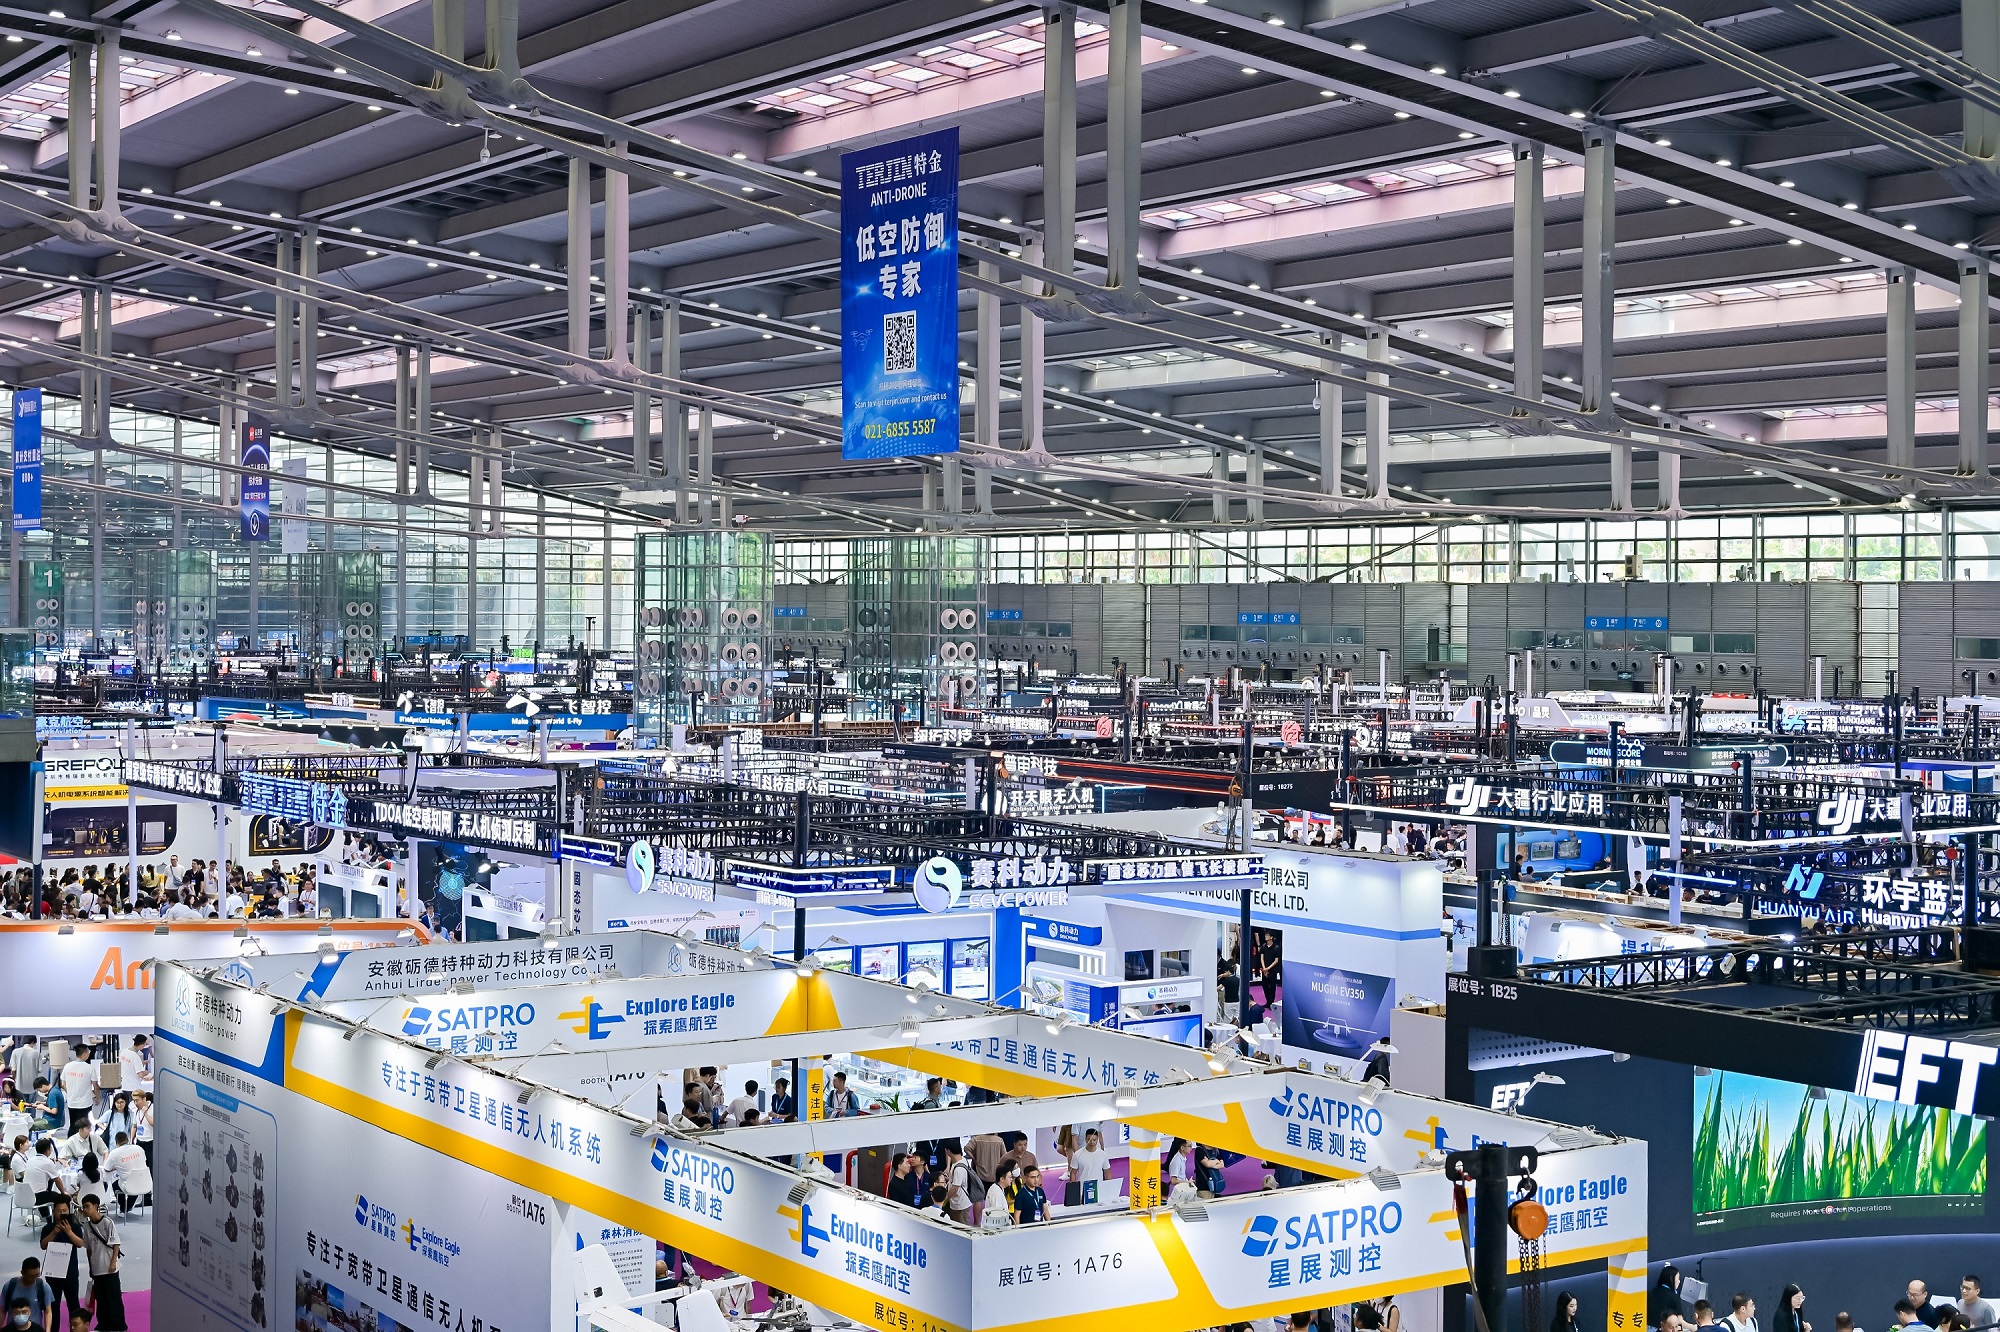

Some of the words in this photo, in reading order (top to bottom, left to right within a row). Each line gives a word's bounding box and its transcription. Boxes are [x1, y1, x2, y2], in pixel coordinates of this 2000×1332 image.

[914, 149, 942, 175] 特金
[870, 182, 927, 206] ANTI-DRONE
[856, 212, 944, 262] 低空防御
[879, 260, 921, 300] 专家
[854, 400, 866, 408] Scan
[940, 392, 947, 400] us
[864, 421, 910, 440] 021-6855
[912, 418, 936, 436] 5587
[44, 570, 52, 587] 1
[548, 700, 612, 715] 一飞智控
[1838, 716, 1876, 725] YUNXIANG
[1586, 746, 1642, 758] MORNIGCORE
[1010, 788, 1094, 806] 开天眼无人机
[1496, 784, 1604, 816] 大疆行业应用
[1868, 794, 1968, 820] 大疆业应用
[460, 813, 536, 846] 无人机侦测反制
[658, 847, 714, 882] 赛科动力
[970, 857, 1070, 888] 赛科动力
[1284, 895, 1308, 912] LTD.
[90, 946, 155, 990] An
[368, 944, 615, 978] 安徽砺德特种动力科技有限公司
[365, 976, 402, 991] Anhui
[494, 966, 568, 982] Technology
[1311, 980, 1338, 997] MUGIN
[1340, 984, 1366, 1000] EV350
[195, 992, 242, 1025] 砺德特种动力
[437, 1002, 536, 1033] SATPRO
[626, 996, 688, 1017] Explore
[691, 992, 735, 1012] Eagle
[643, 1014, 718, 1036] 探索鹰航空
[425, 1030, 518, 1056] 星展测控
[580, 1076, 606, 1085] BOOTH
[1854, 1028, 1999, 1116] EFT
[382, 1060, 602, 1164] 专注于宽带卫星通信无人机系统
[1298, 1092, 1383, 1137] SATPRO
[1286, 1122, 1368, 1164] 星展测控
[671, 1148, 735, 1195] SATPRO
[663, 1178, 723, 1222] 星展测控
[1579, 1174, 1627, 1200] Eagle
[371, 1202, 397, 1228] SATPRO
[506, 1204, 522, 1217] BOOTH
[521, 1198, 546, 1226] 1A76
[1284, 1200, 1402, 1250] SATPRO
[1770, 1210, 1800, 1220] Requires
[1852, 1204, 1892, 1214] operations
[422, 1226, 444, 1247] Explore
[444, 1232, 461, 1256] Eagle
[830, 1212, 884, 1252] Explore
[886, 1232, 928, 1270] Eagle
[421, 1244, 450, 1268] 探索鹰航空
[1268, 1242, 1382, 1289] 星展测控
[306, 1230, 501, 1332] 专注于宽带卫星通信无人机
[844, 1250, 911, 1296] 探索鹰航空
[1612, 1310, 1625, 1329] 专
[1632, 1308, 1644, 1328] 专
